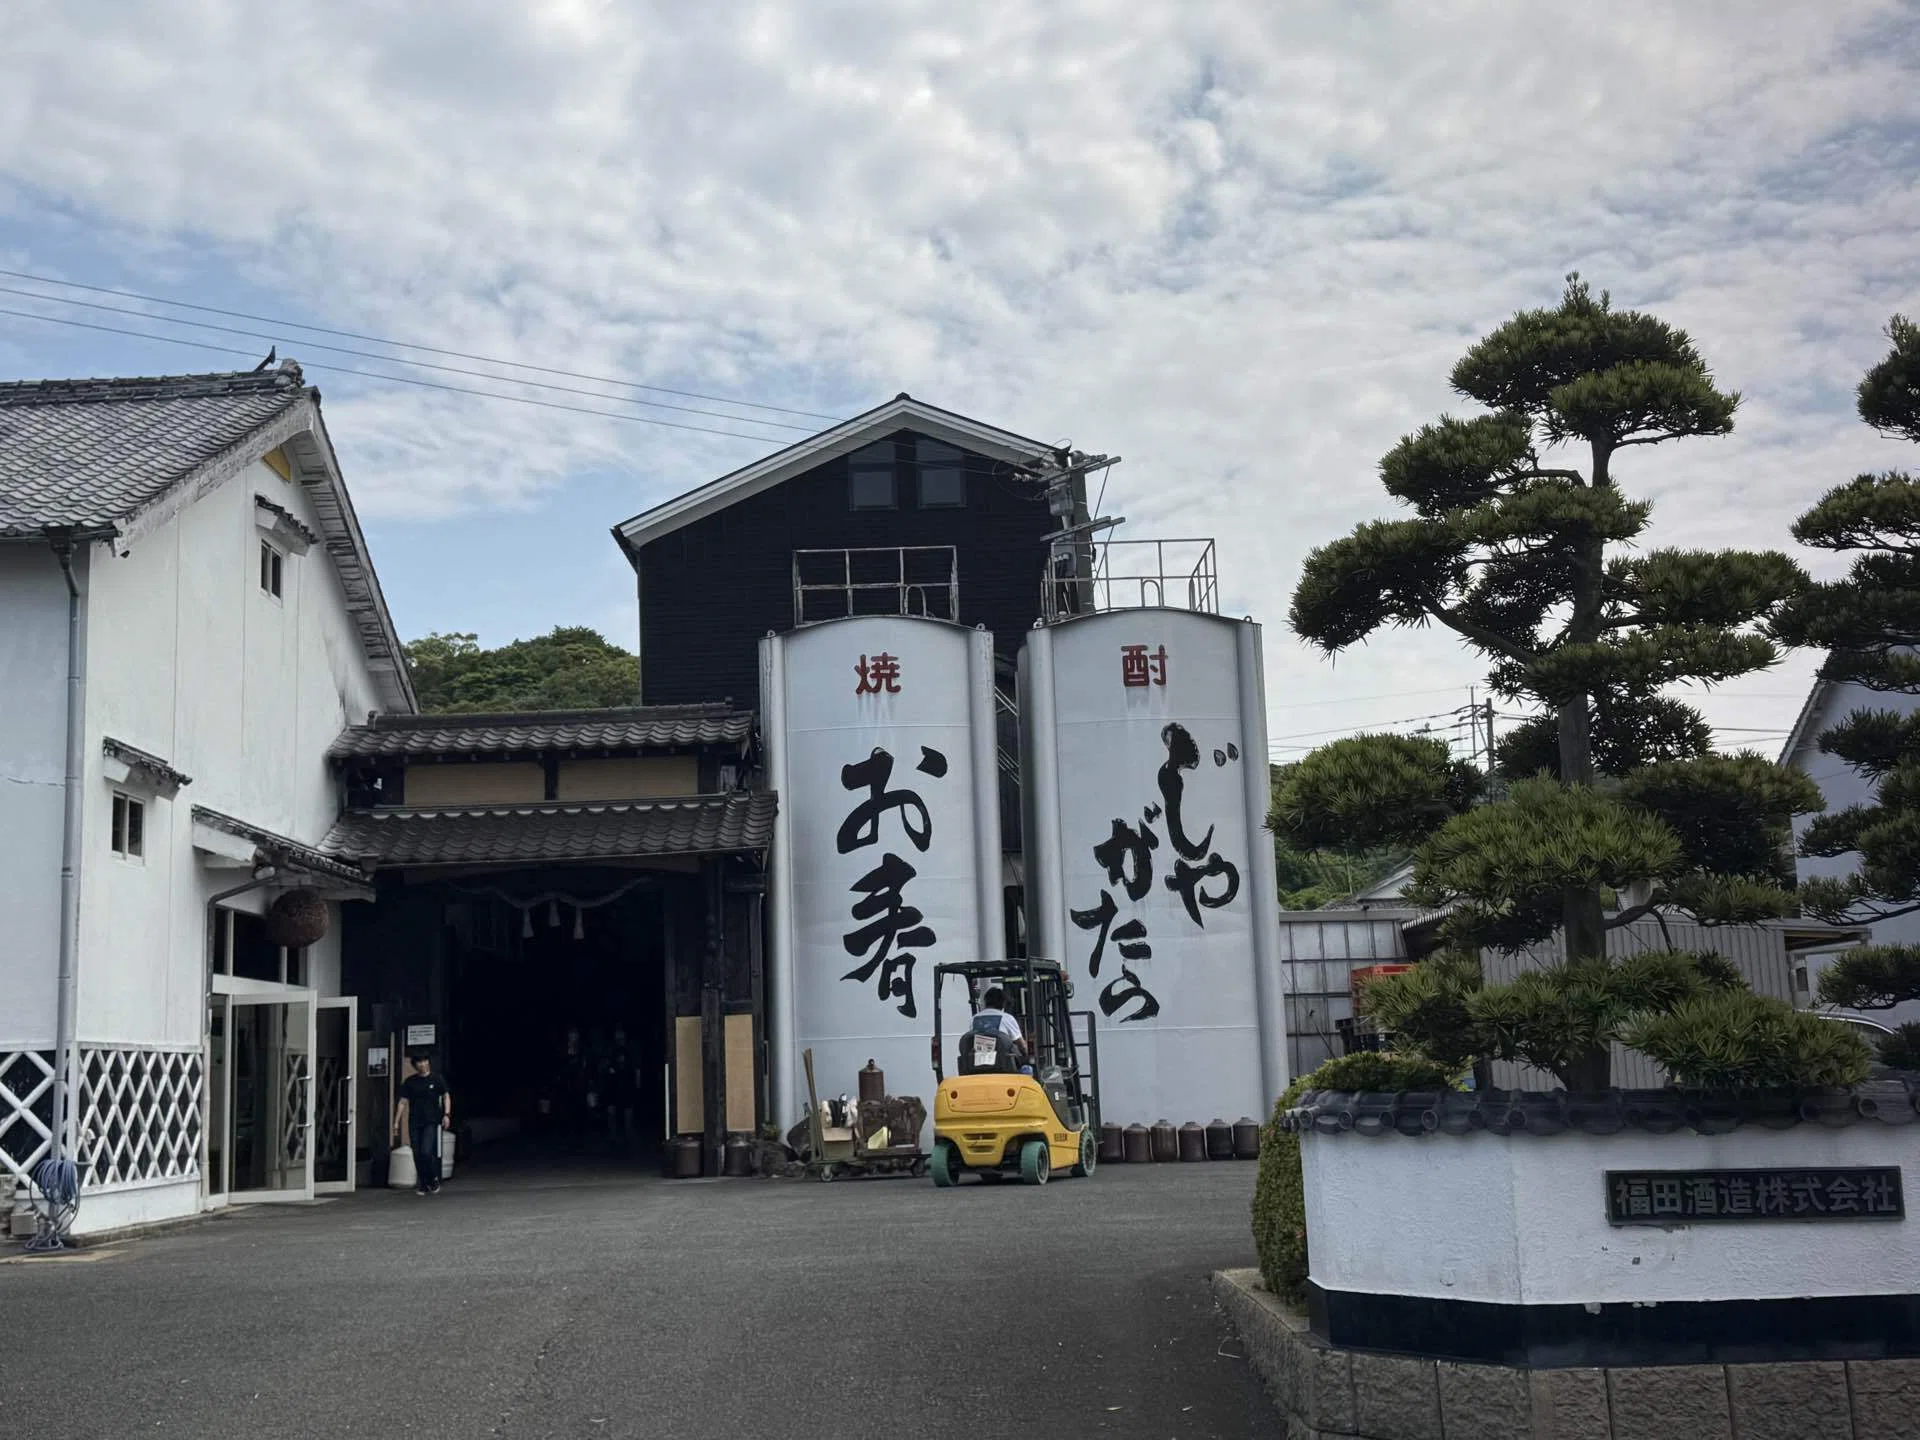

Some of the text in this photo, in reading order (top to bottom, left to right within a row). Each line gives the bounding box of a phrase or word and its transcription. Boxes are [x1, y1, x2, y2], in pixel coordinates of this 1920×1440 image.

[855, 652, 901, 695] 焼
[1121, 644, 1168, 687] 酎
[1616, 1175, 1897, 1217] 福田酒造株式会社
